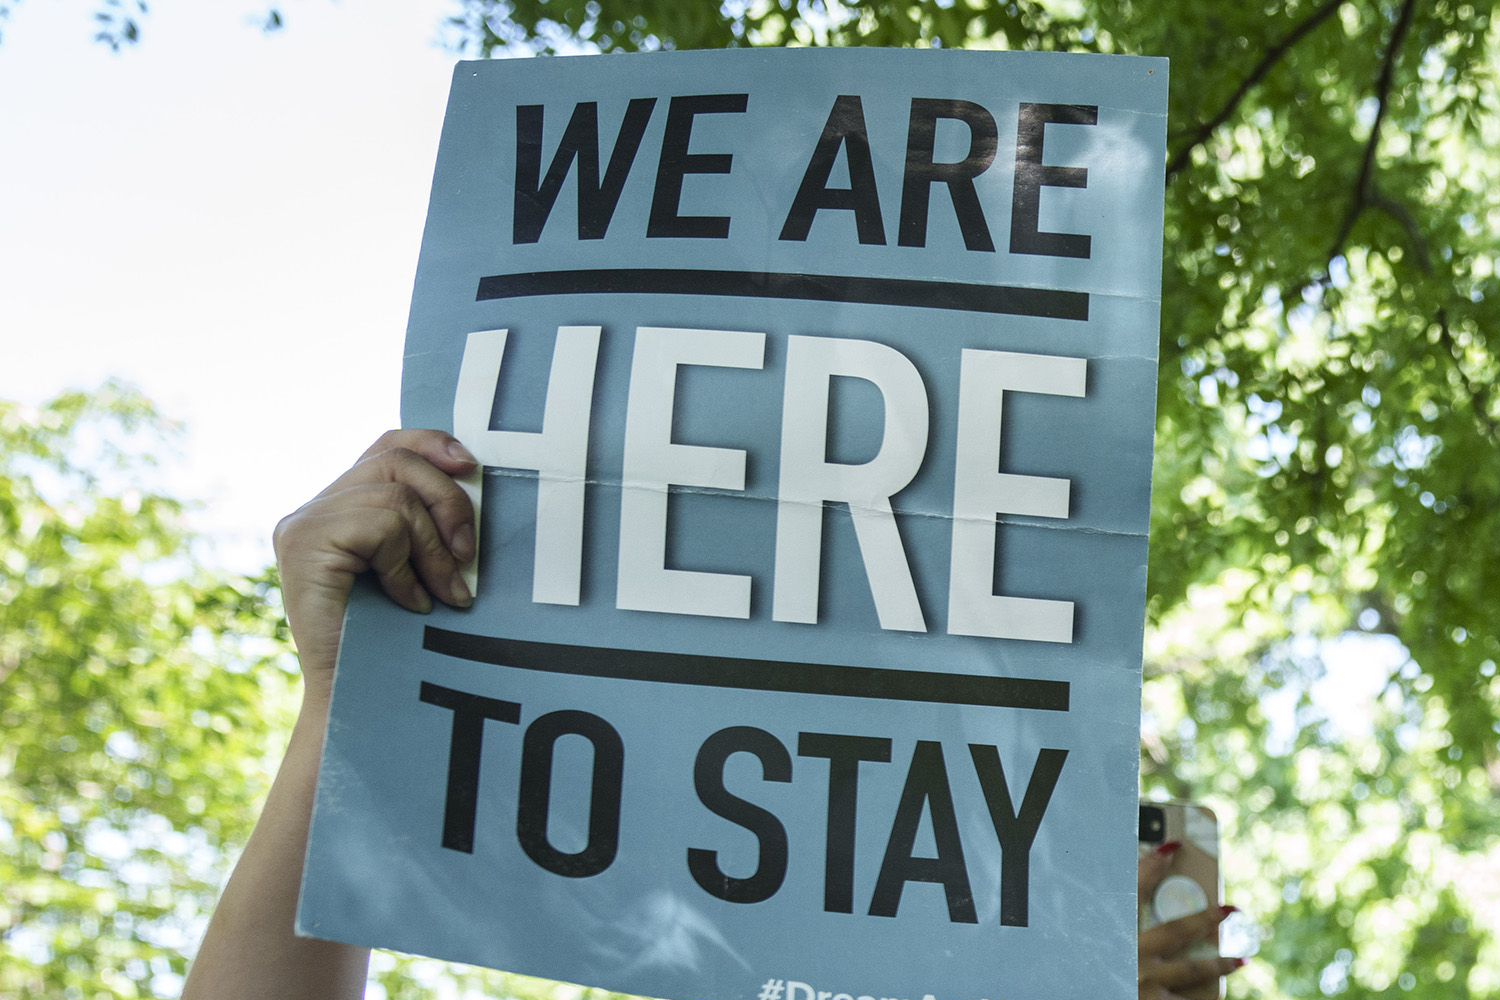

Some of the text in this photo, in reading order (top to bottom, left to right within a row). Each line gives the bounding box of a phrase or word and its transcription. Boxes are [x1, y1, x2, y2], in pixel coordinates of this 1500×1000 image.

[512, 93, 1098, 259] WE ARE
[452, 325, 1088, 644] HERE
[418, 681, 1070, 928] TO STAY
